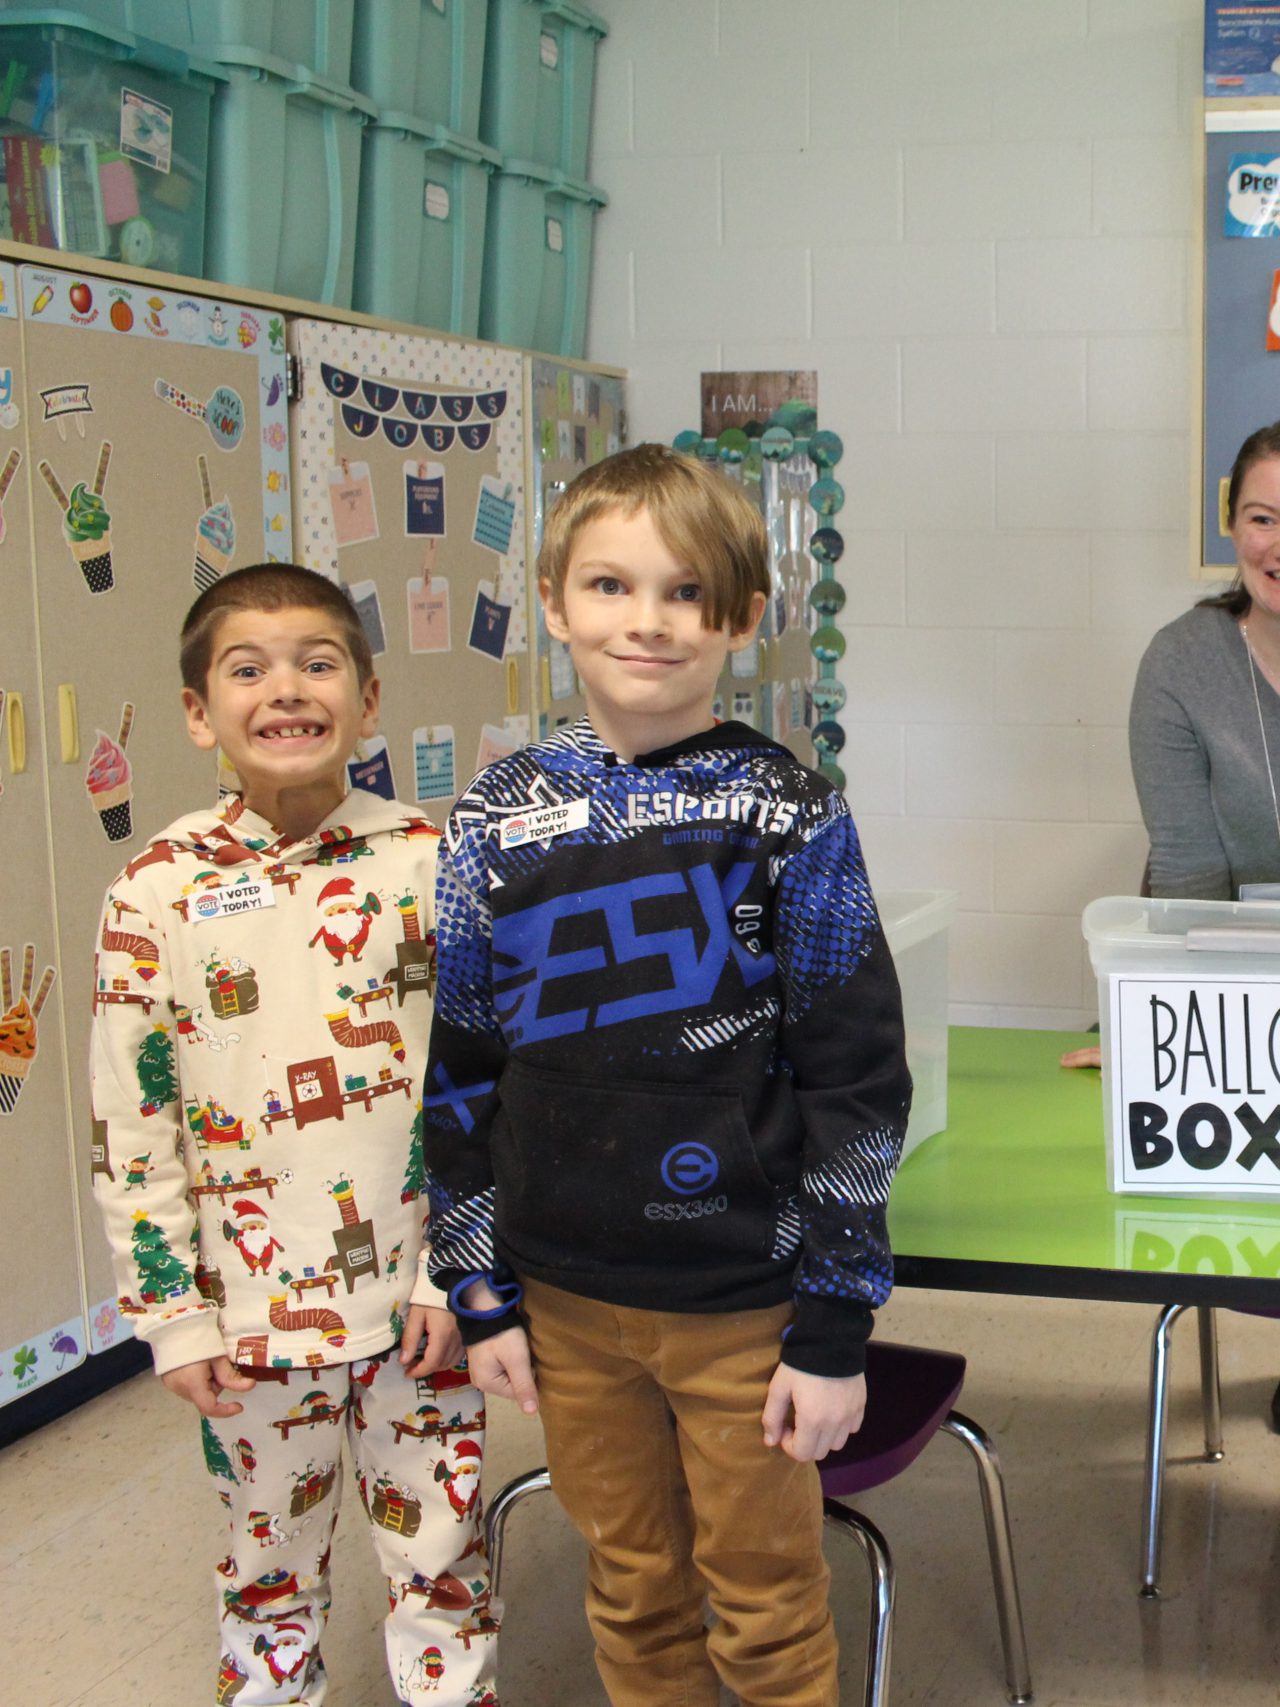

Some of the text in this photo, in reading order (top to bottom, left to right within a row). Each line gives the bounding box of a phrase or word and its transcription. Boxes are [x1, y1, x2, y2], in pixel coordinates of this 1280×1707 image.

[331, 373, 497, 419] CLASS
[711, 396, 717, 413] I
[353, 414, 480, 448] JOBS
[535, 809, 569, 824] VOTED
[627, 791, 799, 835] ESPORTS
[506, 826, 526, 837] VOTE
[529, 821, 567, 838] TODAY!
[663, 829, 723, 846] GAMING
[226, 886, 261, 899] VOTED
[198, 901, 217, 910] VOTE
[222, 897, 262, 912] TODAY!
[294, 1070, 317, 1084] X-RAY
